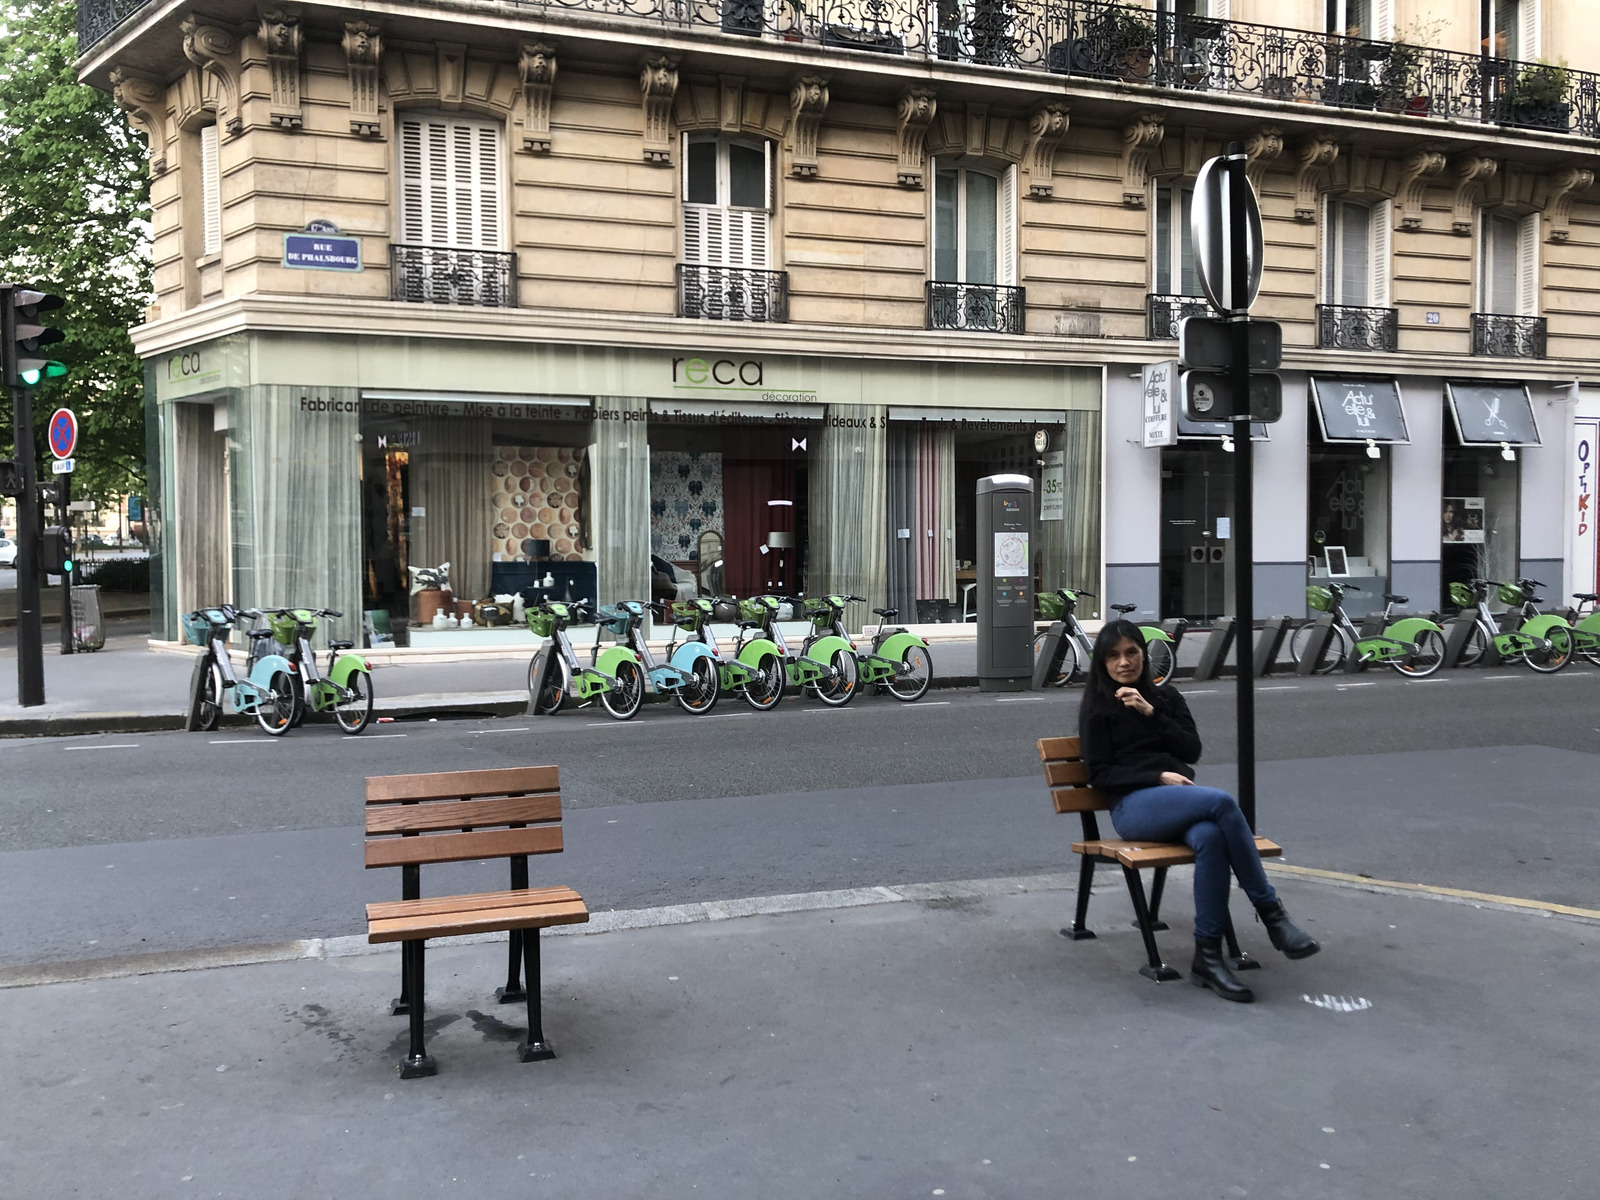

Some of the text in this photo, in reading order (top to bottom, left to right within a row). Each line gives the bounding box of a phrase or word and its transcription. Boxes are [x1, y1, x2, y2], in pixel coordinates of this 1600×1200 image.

[314, 243, 332, 251] RUE
[302, 253, 358, 264] PHALSBOURG
[1427, 313, 1439, 323] 20
[168, 351, 200, 380] reca
[672, 356, 764, 386] reca
[762, 391, 817, 402] décoration
[371, 401, 389, 413] de
[393, 402, 450, 416] peinture
[463, 402, 493, 416] Mise
[510, 404, 522, 417] la
[526, 404, 561, 419] teinte
[575, 406, 620, 422] Papiers
[662, 410, 670, 422] &
[674, 409, 705, 424] Tissus
[870, 416, 877, 429] &
[961, 418, 1027, 432] Revêtements
